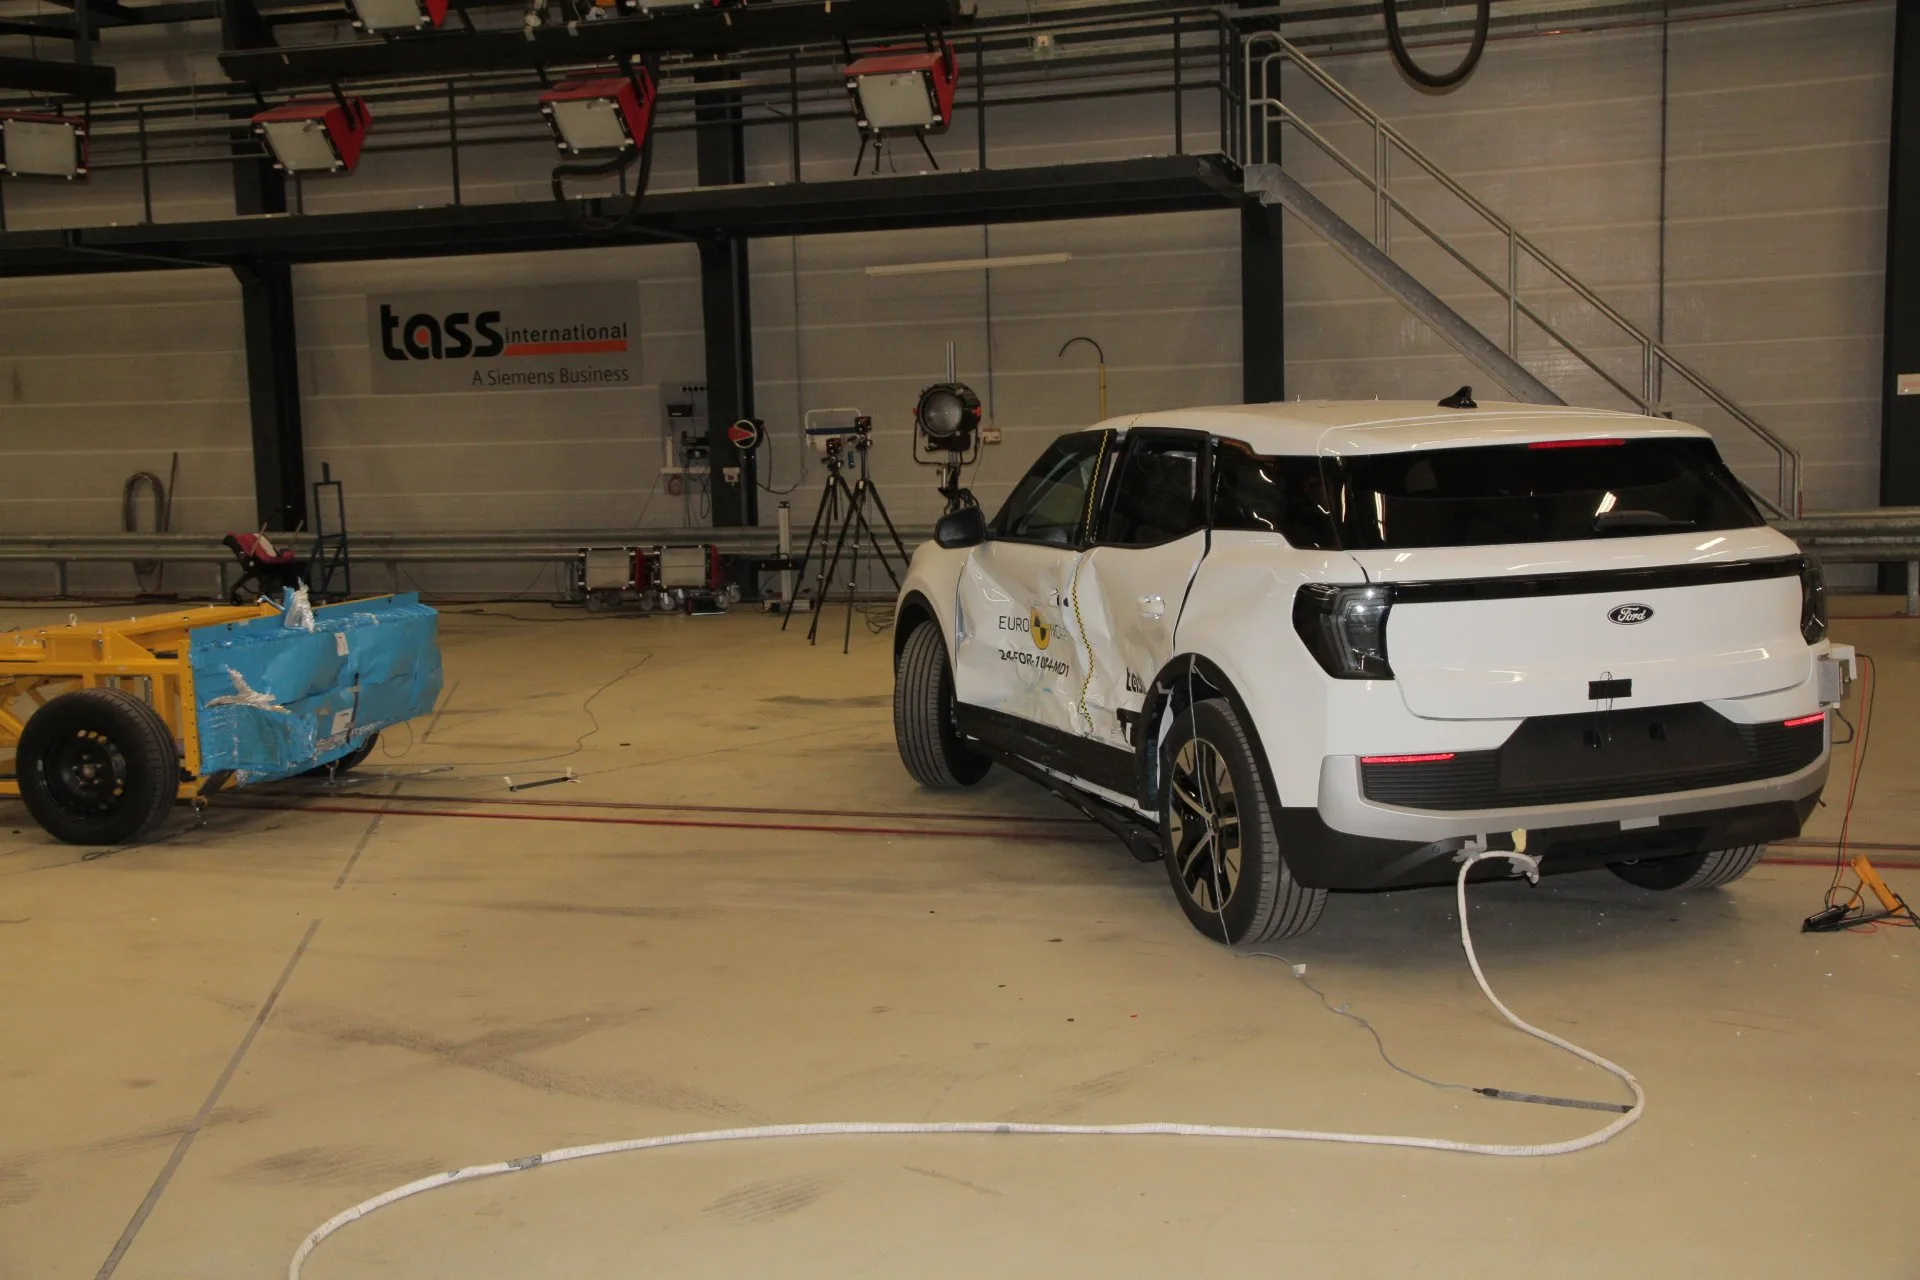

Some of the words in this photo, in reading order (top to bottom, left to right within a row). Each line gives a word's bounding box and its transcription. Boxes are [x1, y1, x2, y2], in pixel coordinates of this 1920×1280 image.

[380, 304, 504, 361] tass
[505, 322, 627, 343] international
[472, 371, 483, 386] A
[488, 369, 555, 386] Siemens
[560, 367, 629, 384] Business
[1618, 607, 1647, 622] Ford
[999, 615, 1030, 633] EURO
